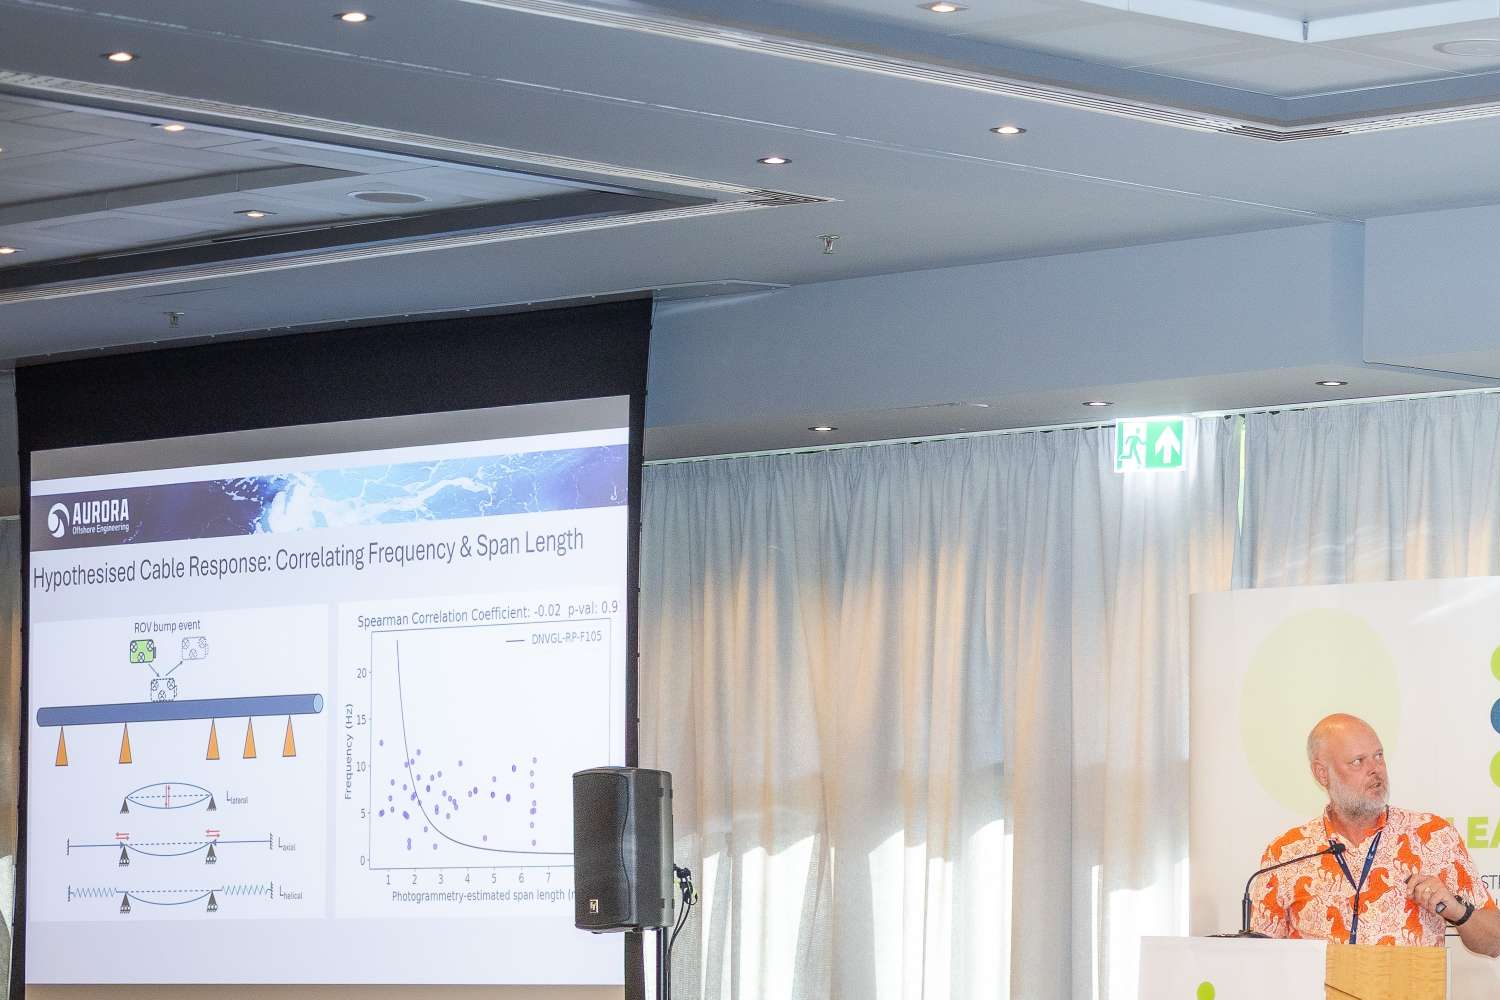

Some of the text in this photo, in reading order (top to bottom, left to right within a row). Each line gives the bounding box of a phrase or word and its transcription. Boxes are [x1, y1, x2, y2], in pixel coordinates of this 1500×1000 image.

[72, 498, 130, 526] AURORA
[72, 522, 130, 535] Offshore Engineering
[33, 528, 584, 592] Hypothesised Cable Response: Correlating Frequency & Span Length
[357, 614, 409, 630] Spearman
[411, 609, 468, 625] Correlation
[471, 605, 530, 621] Coefficient:
[534, 603, 561, 617] -0.02
[568, 600, 598, 617] p-val:
[134, 620, 201, 633] ROV bump event
[532, 630, 602, 645] DNVGL-RP-F105
[356, 668, 367, 679] 20
[357, 715, 367, 725] 15
[345, 703, 354, 800] Frequency (Hz)
[356, 762, 366, 772] 10
[360, 808, 366, 819] 5
[360, 855, 366, 866] 0
[386, 872, 551, 885] 1 2 3 4 5 6 7
[392, 889, 511, 904] Photogrammetry-estimated
[513, 891, 534, 903] span
[537, 889, 566, 902] length
